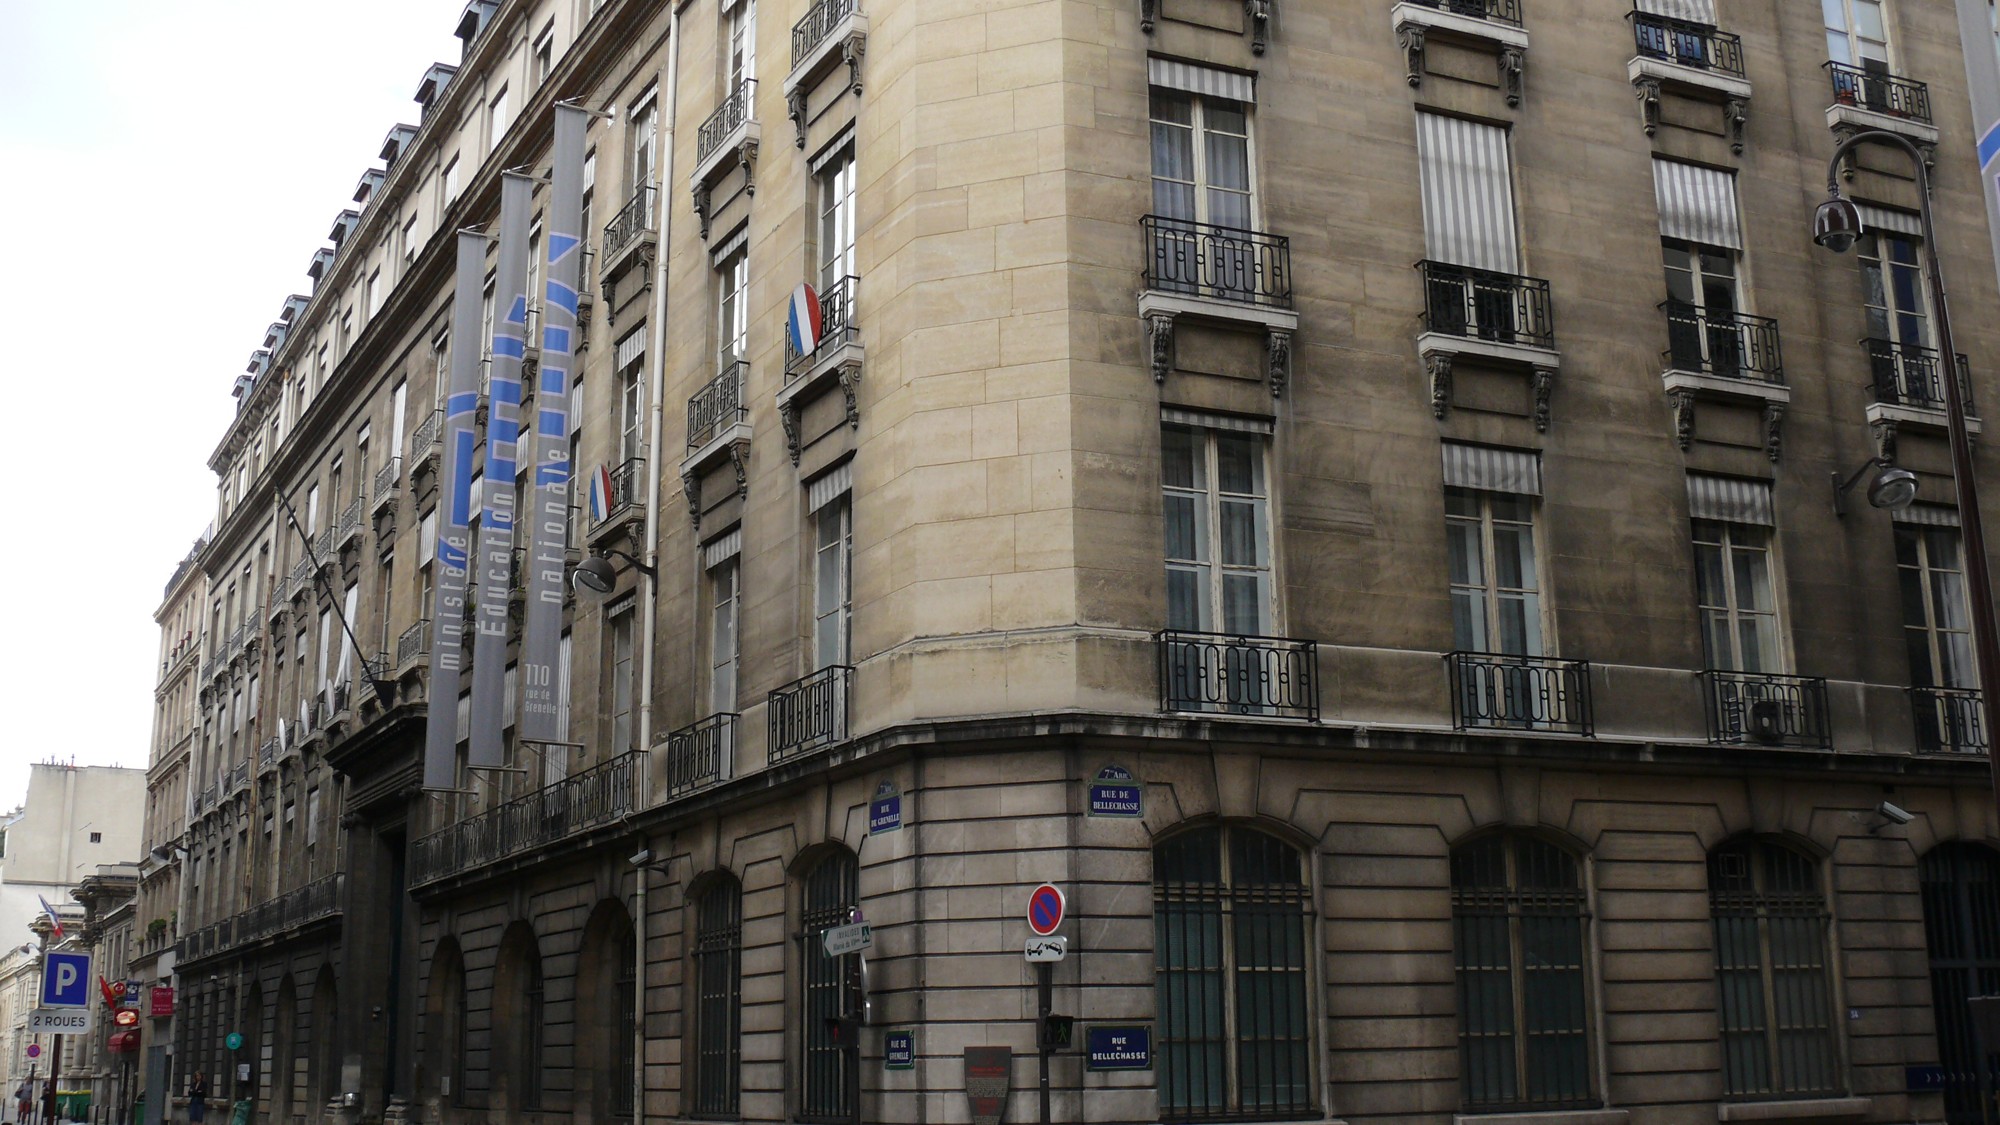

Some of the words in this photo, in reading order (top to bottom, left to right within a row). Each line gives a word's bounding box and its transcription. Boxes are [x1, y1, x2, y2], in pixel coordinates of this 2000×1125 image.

[538, 449, 570, 604] nationale
[475, 492, 513, 637] Éducation
[437, 536, 467, 671] ministère
[525, 663, 550, 687] 110
[525, 689, 539, 699] rue
[540, 690, 550, 700] de
[525, 701, 557, 715] Grenelle
[1101, 790, 1117, 799] RUE
[1119, 790, 1129, 799] DE
[880, 804, 890, 814] RUE
[1093, 801, 1139, 811] BELLECHASSE
[877, 813, 900, 826] GRENELLE
[55, 962, 77, 996] P
[33, 1016, 41, 1026] 2
[45, 1016, 86, 1027] ROUES
[890, 1040, 900, 1049] RUE
[900, 1039, 907, 1049] DE
[1111, 1037, 1127, 1045] RUE
[889, 1051, 909, 1061] GRENELLE
[1092, 1052, 1146, 1061] BELLECHASSE
